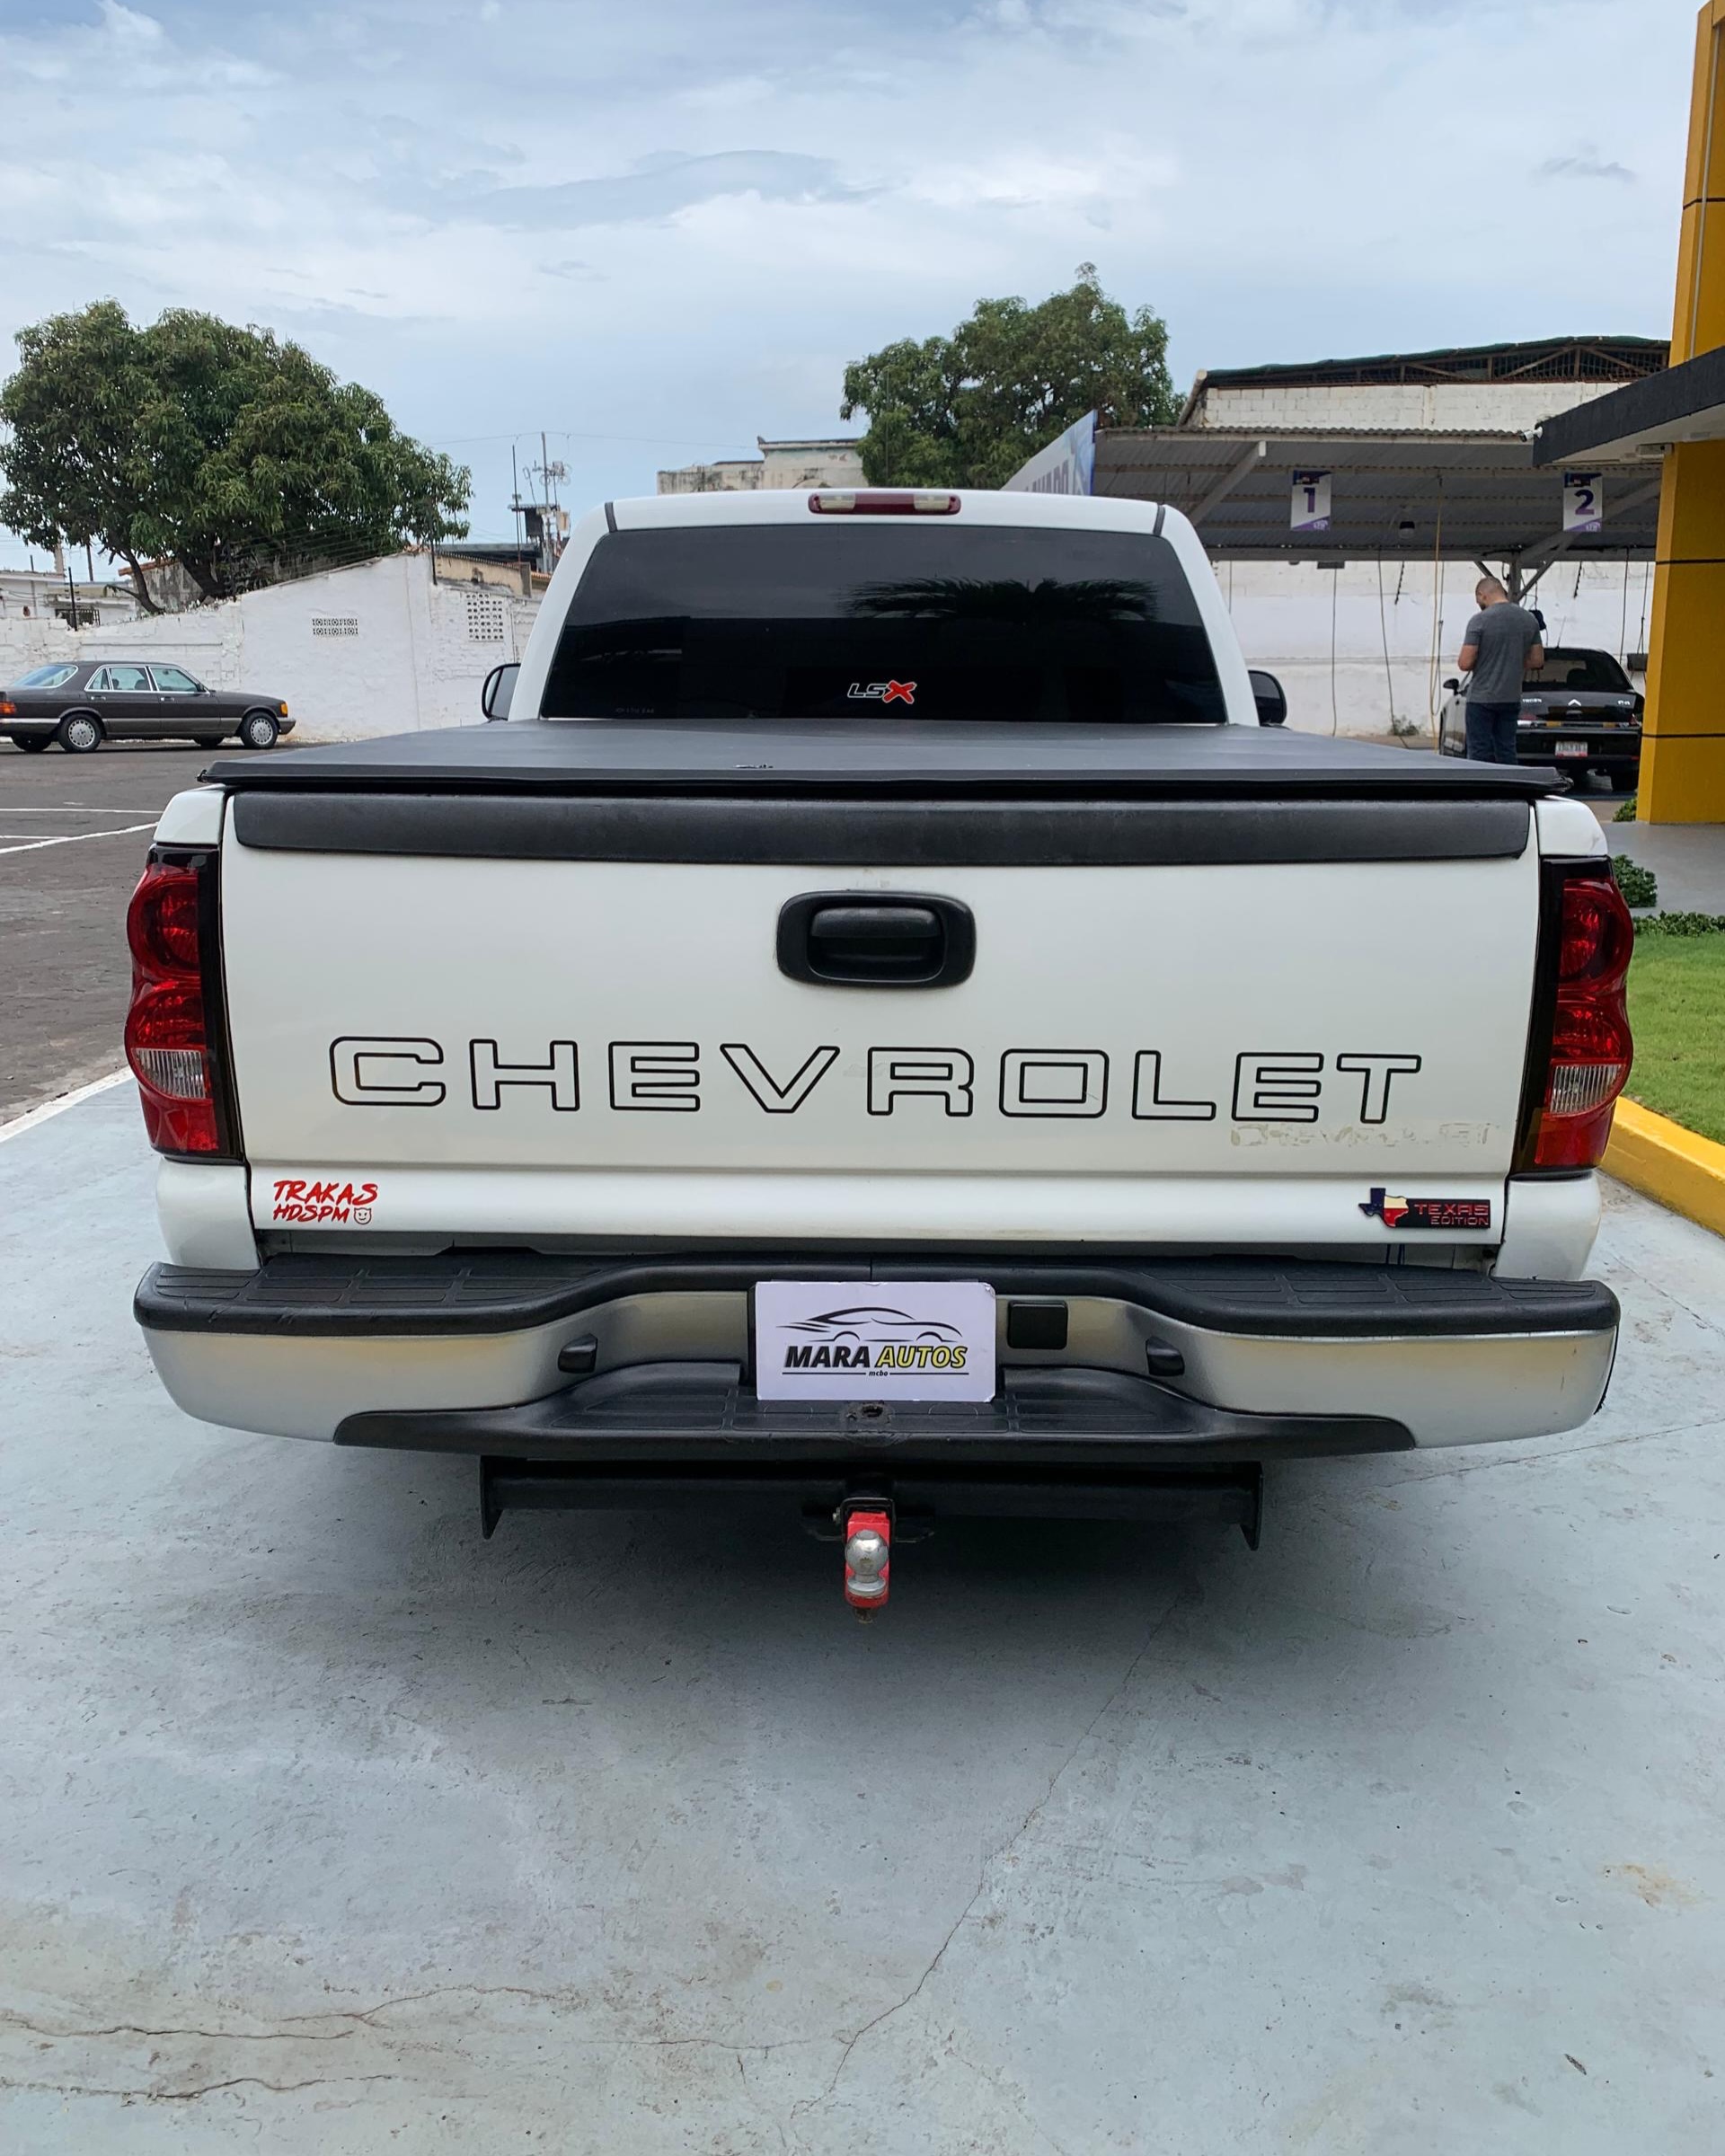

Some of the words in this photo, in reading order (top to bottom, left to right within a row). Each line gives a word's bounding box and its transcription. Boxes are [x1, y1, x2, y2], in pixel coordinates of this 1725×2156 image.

[1303, 487, 1315, 513] 1
[1574, 490, 1595, 515] 2
[847, 679, 917, 704] LSX
[329, 1036, 1422, 1124] CHEVROLET
[273, 1180, 378, 1206] TRAKAS
[273, 1204, 350, 1224] HDSPM
[1413, 1203, 1489, 1215] TEXAS
[1430, 1215, 1489, 1225] EDITION
[784, 1345, 871, 1368] MARA
[874, 1345, 968, 1369] AUTOS
